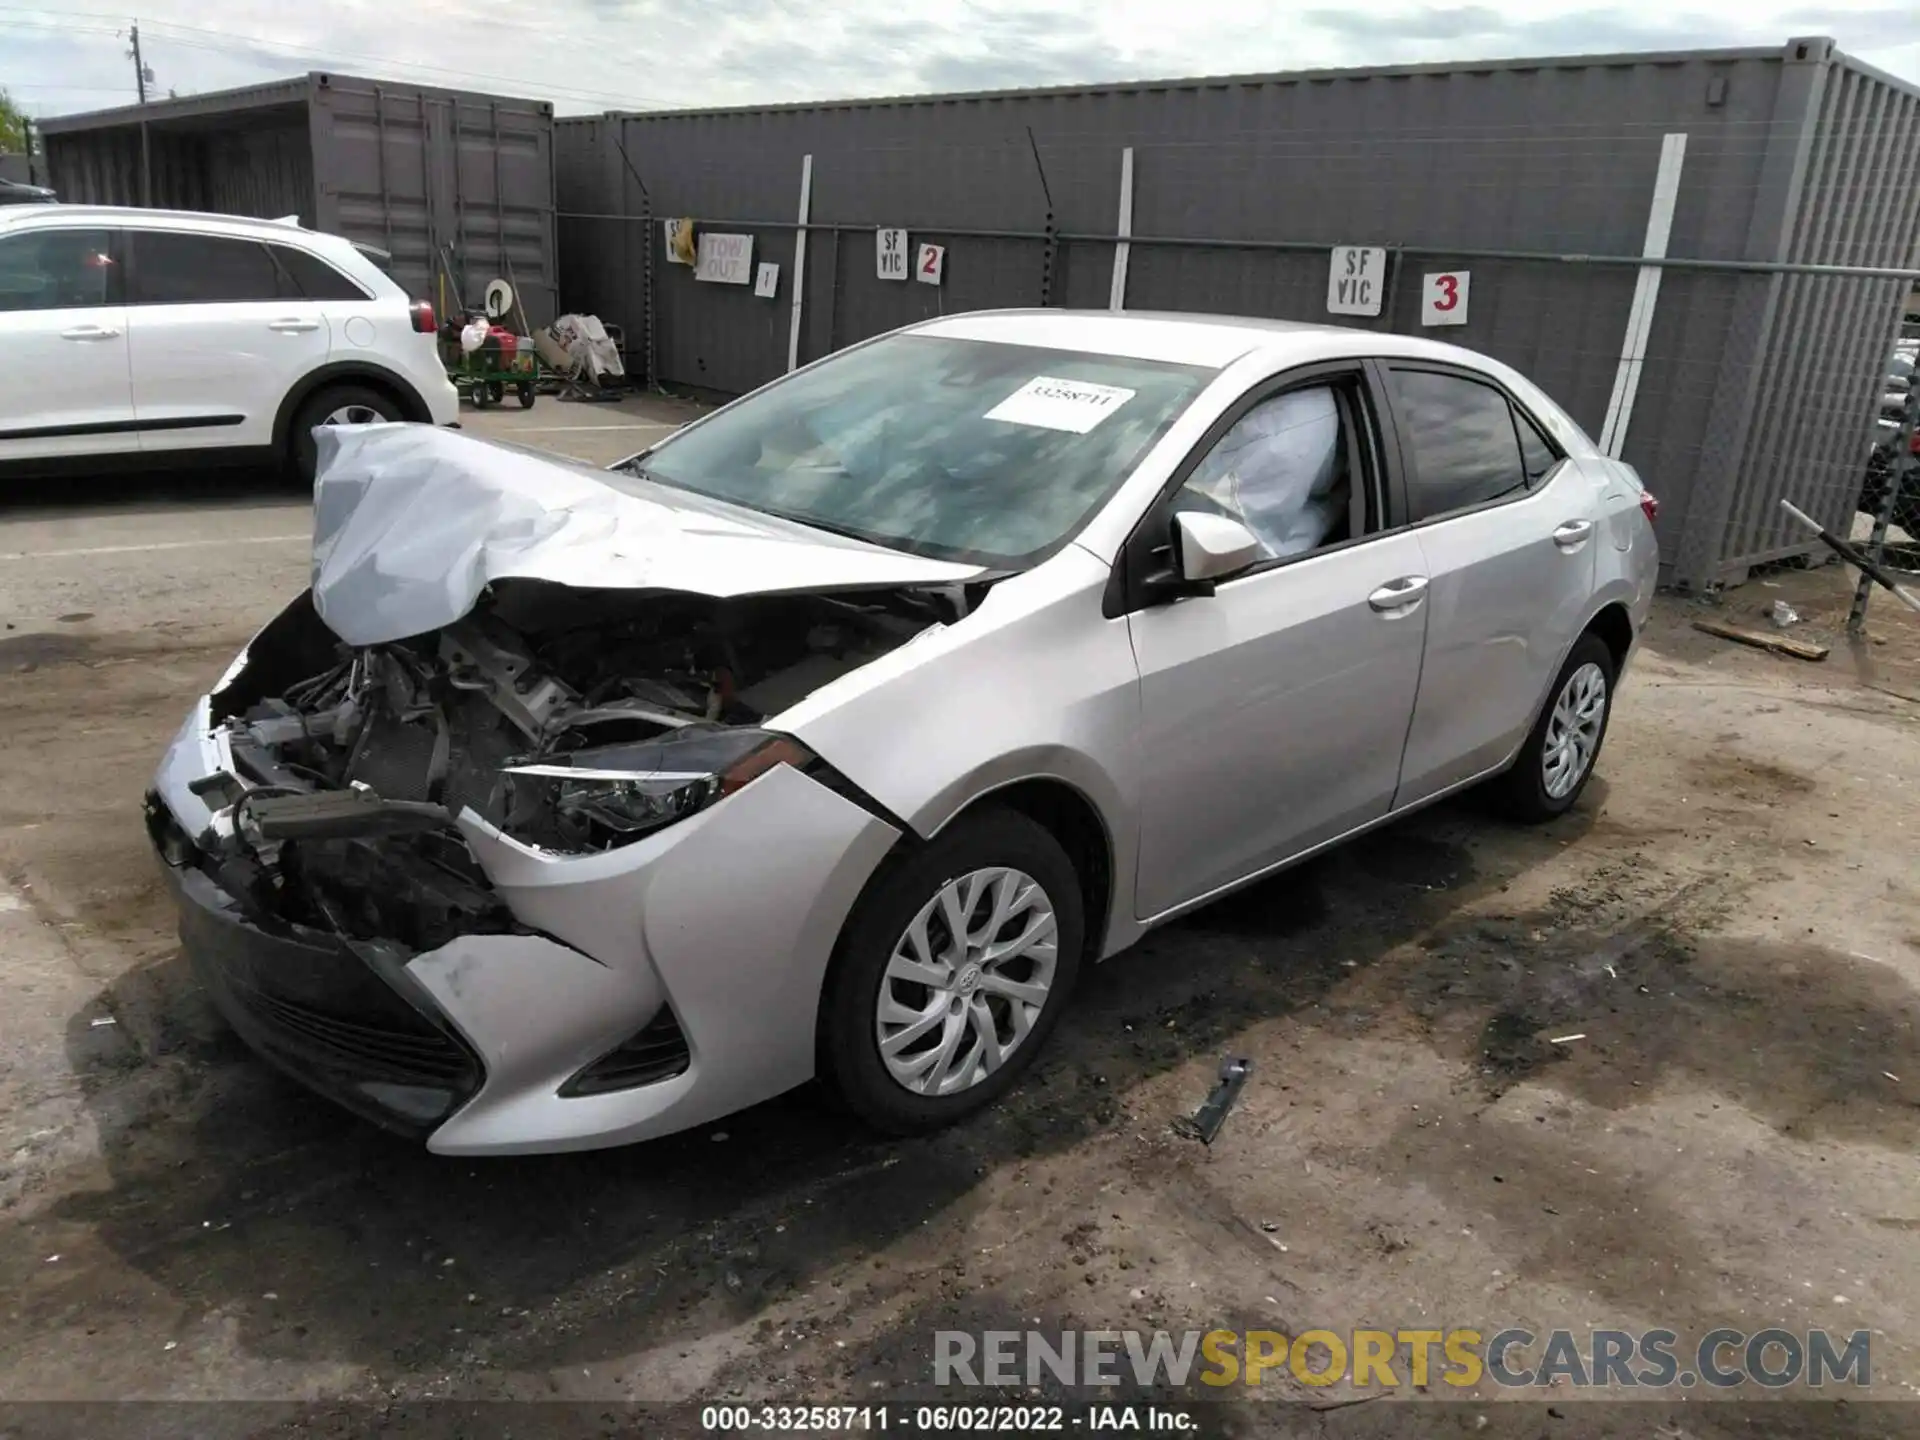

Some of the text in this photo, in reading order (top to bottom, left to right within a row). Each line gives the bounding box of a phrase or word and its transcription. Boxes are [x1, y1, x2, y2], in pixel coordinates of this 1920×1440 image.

[707, 238, 743, 258] TOW
[884, 230, 899, 251] SF
[707, 258, 739, 279] OUT
[922, 247, 938, 273] 2
[1345, 249, 1370, 276] SF
[1337, 278, 1371, 305] VIC
[1433, 274, 1458, 311] 3
